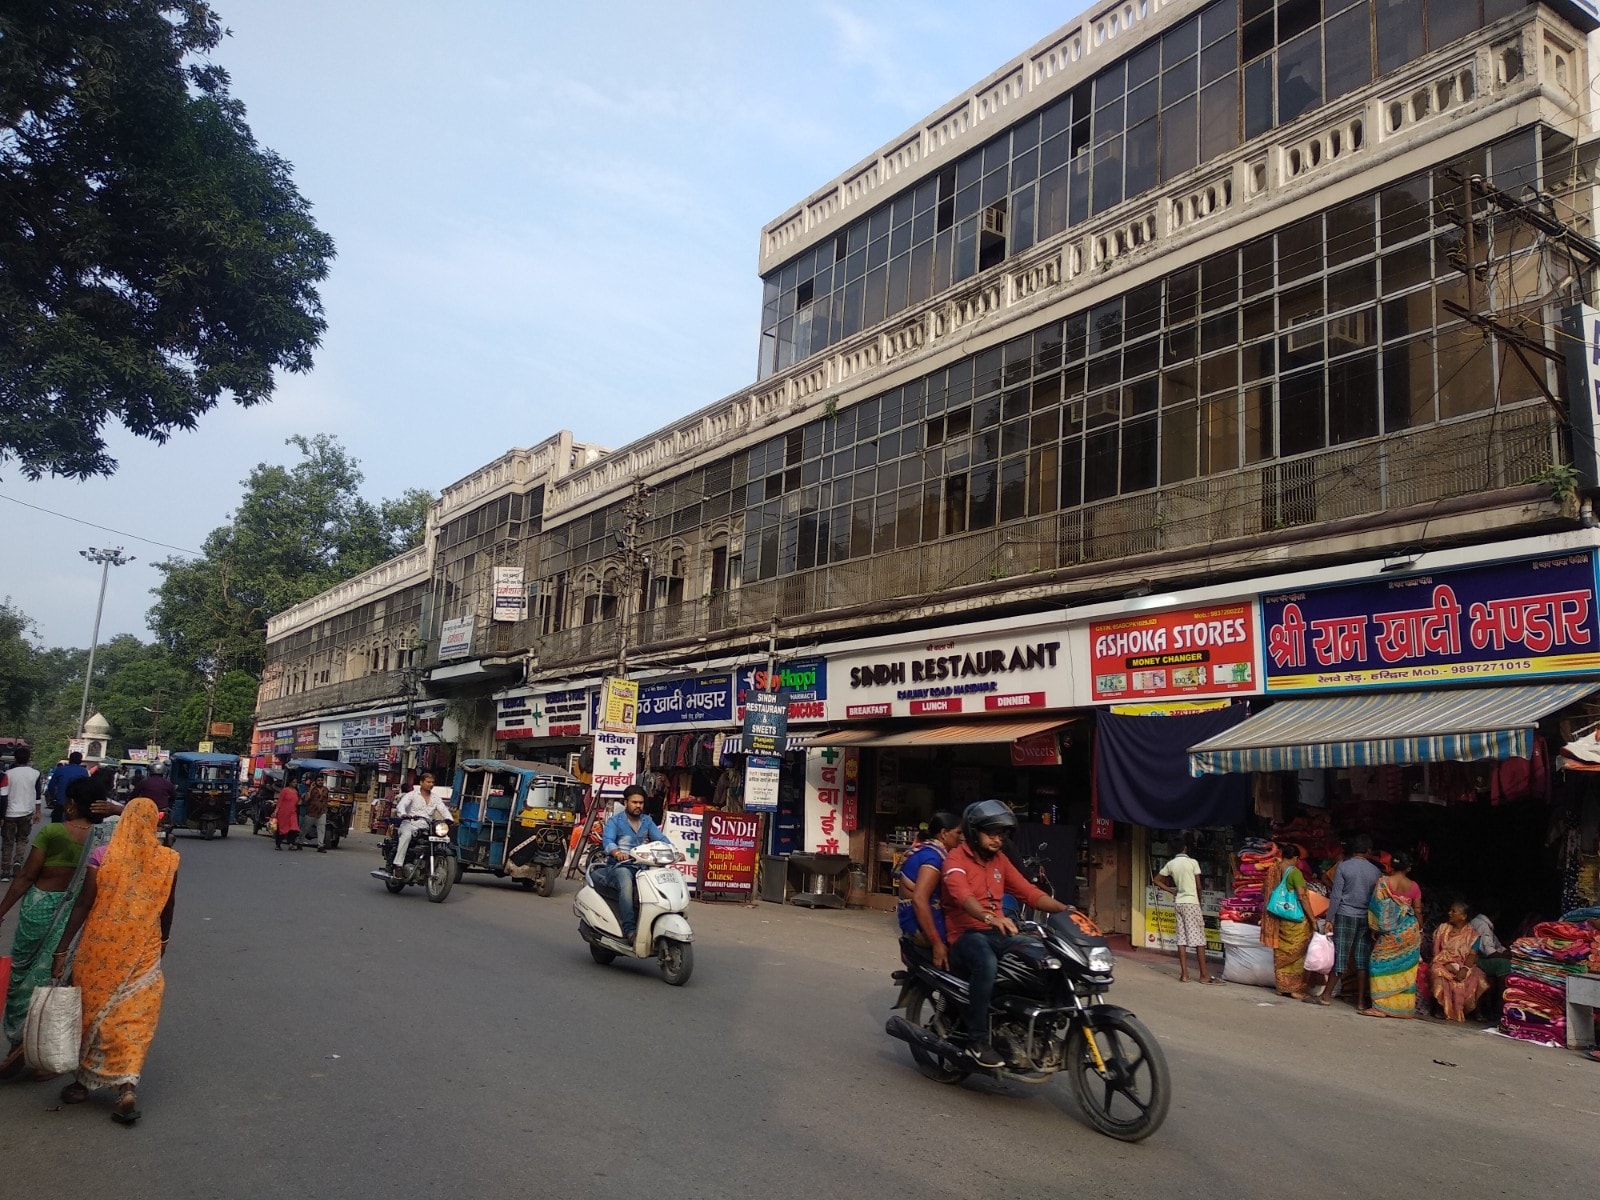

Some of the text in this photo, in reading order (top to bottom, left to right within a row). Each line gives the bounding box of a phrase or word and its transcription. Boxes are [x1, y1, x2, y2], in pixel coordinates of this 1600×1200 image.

[1268, 585, 1591, 667] श्री राम खादी भण्डार
[1096, 618, 1247, 659] ASHOKA STORES
[850, 642, 1060, 688] SINDH RESTAURANT
[1132, 653, 1203, 667] MONEY CHANGER
[1451, 661, 1531, 674] 9897271015
[653, 689, 684, 713] खादी
[686, 690, 727, 710] भण्डार
[757, 693, 777, 703] SINDH
[997, 694, 1030, 707] DINNER
[745, 702, 786, 716] RESTAURANT
[849, 705, 887, 717] BREAKFAST
[922, 701, 947, 711] LUNCH
[762, 714, 768, 724] &
[751, 724, 777, 735] SWEETS
[597, 732, 636, 745] मेडिकल
[606, 745, 627, 756] स्टोर
[1013, 741, 1055, 762] Sweets
[669, 813, 703, 828] मेडिक
[710, 815, 757, 838] SINDH
[1096, 818, 1109, 826] NON
[680, 829, 702, 841] स्टो
[709, 850, 735, 863] Punjabi
[708, 861, 751, 872] South Indian
[707, 870, 734, 881] Chinese
